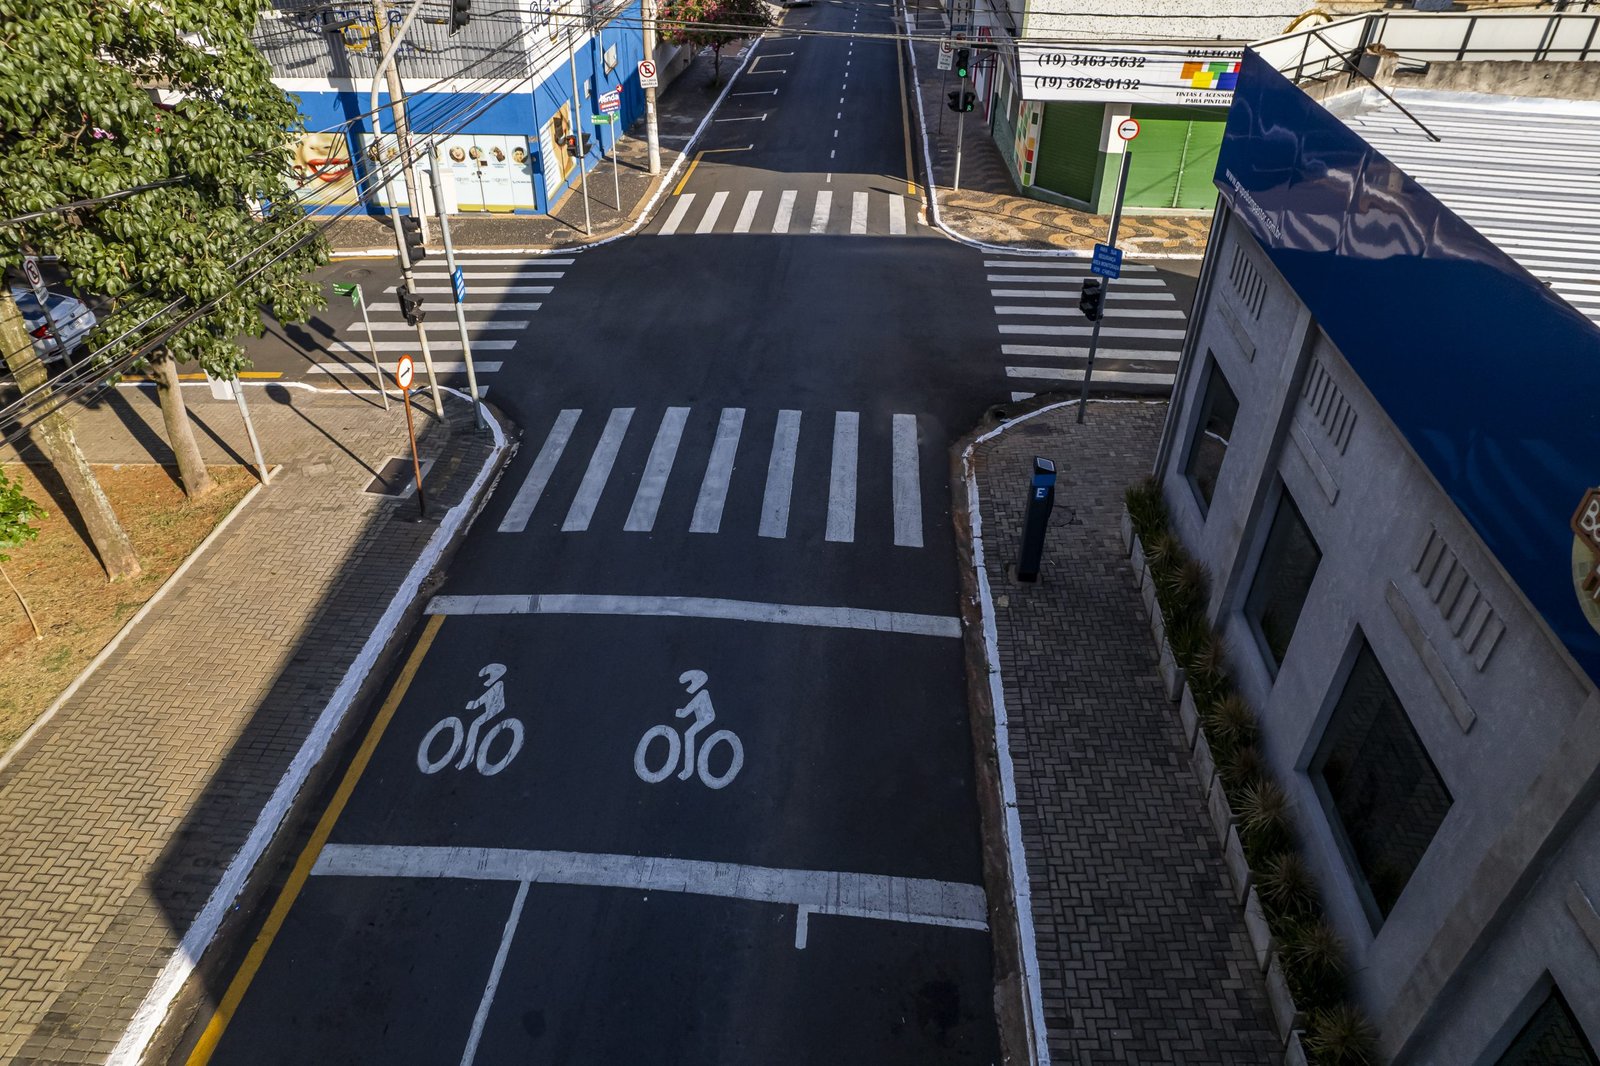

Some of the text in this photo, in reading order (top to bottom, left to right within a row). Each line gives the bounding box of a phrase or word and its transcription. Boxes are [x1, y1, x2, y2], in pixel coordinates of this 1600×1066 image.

[1038, 54, 1146, 68] (19) 3463-5632
[1034, 76, 1141, 90] (19) 3628-0132
[1036, 487, 1045, 498] E
